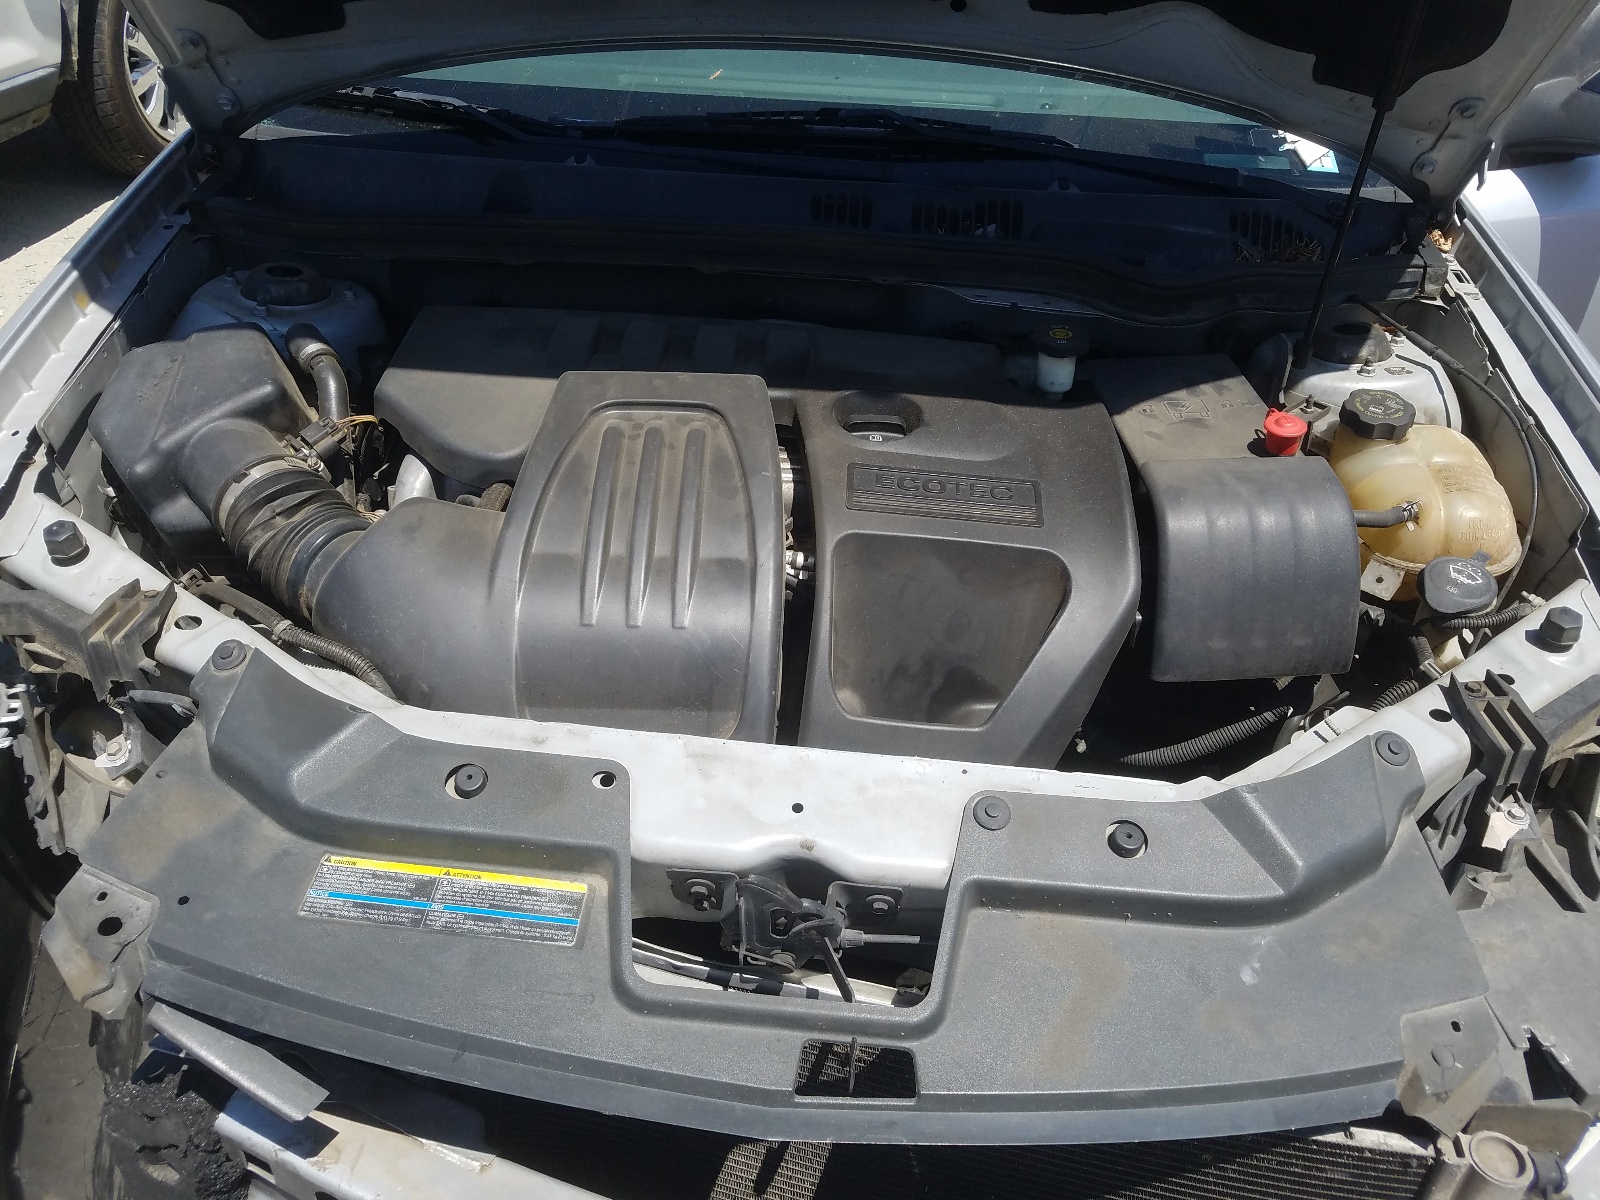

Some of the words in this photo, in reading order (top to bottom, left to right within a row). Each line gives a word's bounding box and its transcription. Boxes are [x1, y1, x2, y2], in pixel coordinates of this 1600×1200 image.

[875, 474, 1014, 501] ECOTEC
[333, 859, 357, 867] CAUTION
[451, 872, 482, 880] ATTENTION
[308, 889, 329, 897] NOTICE
